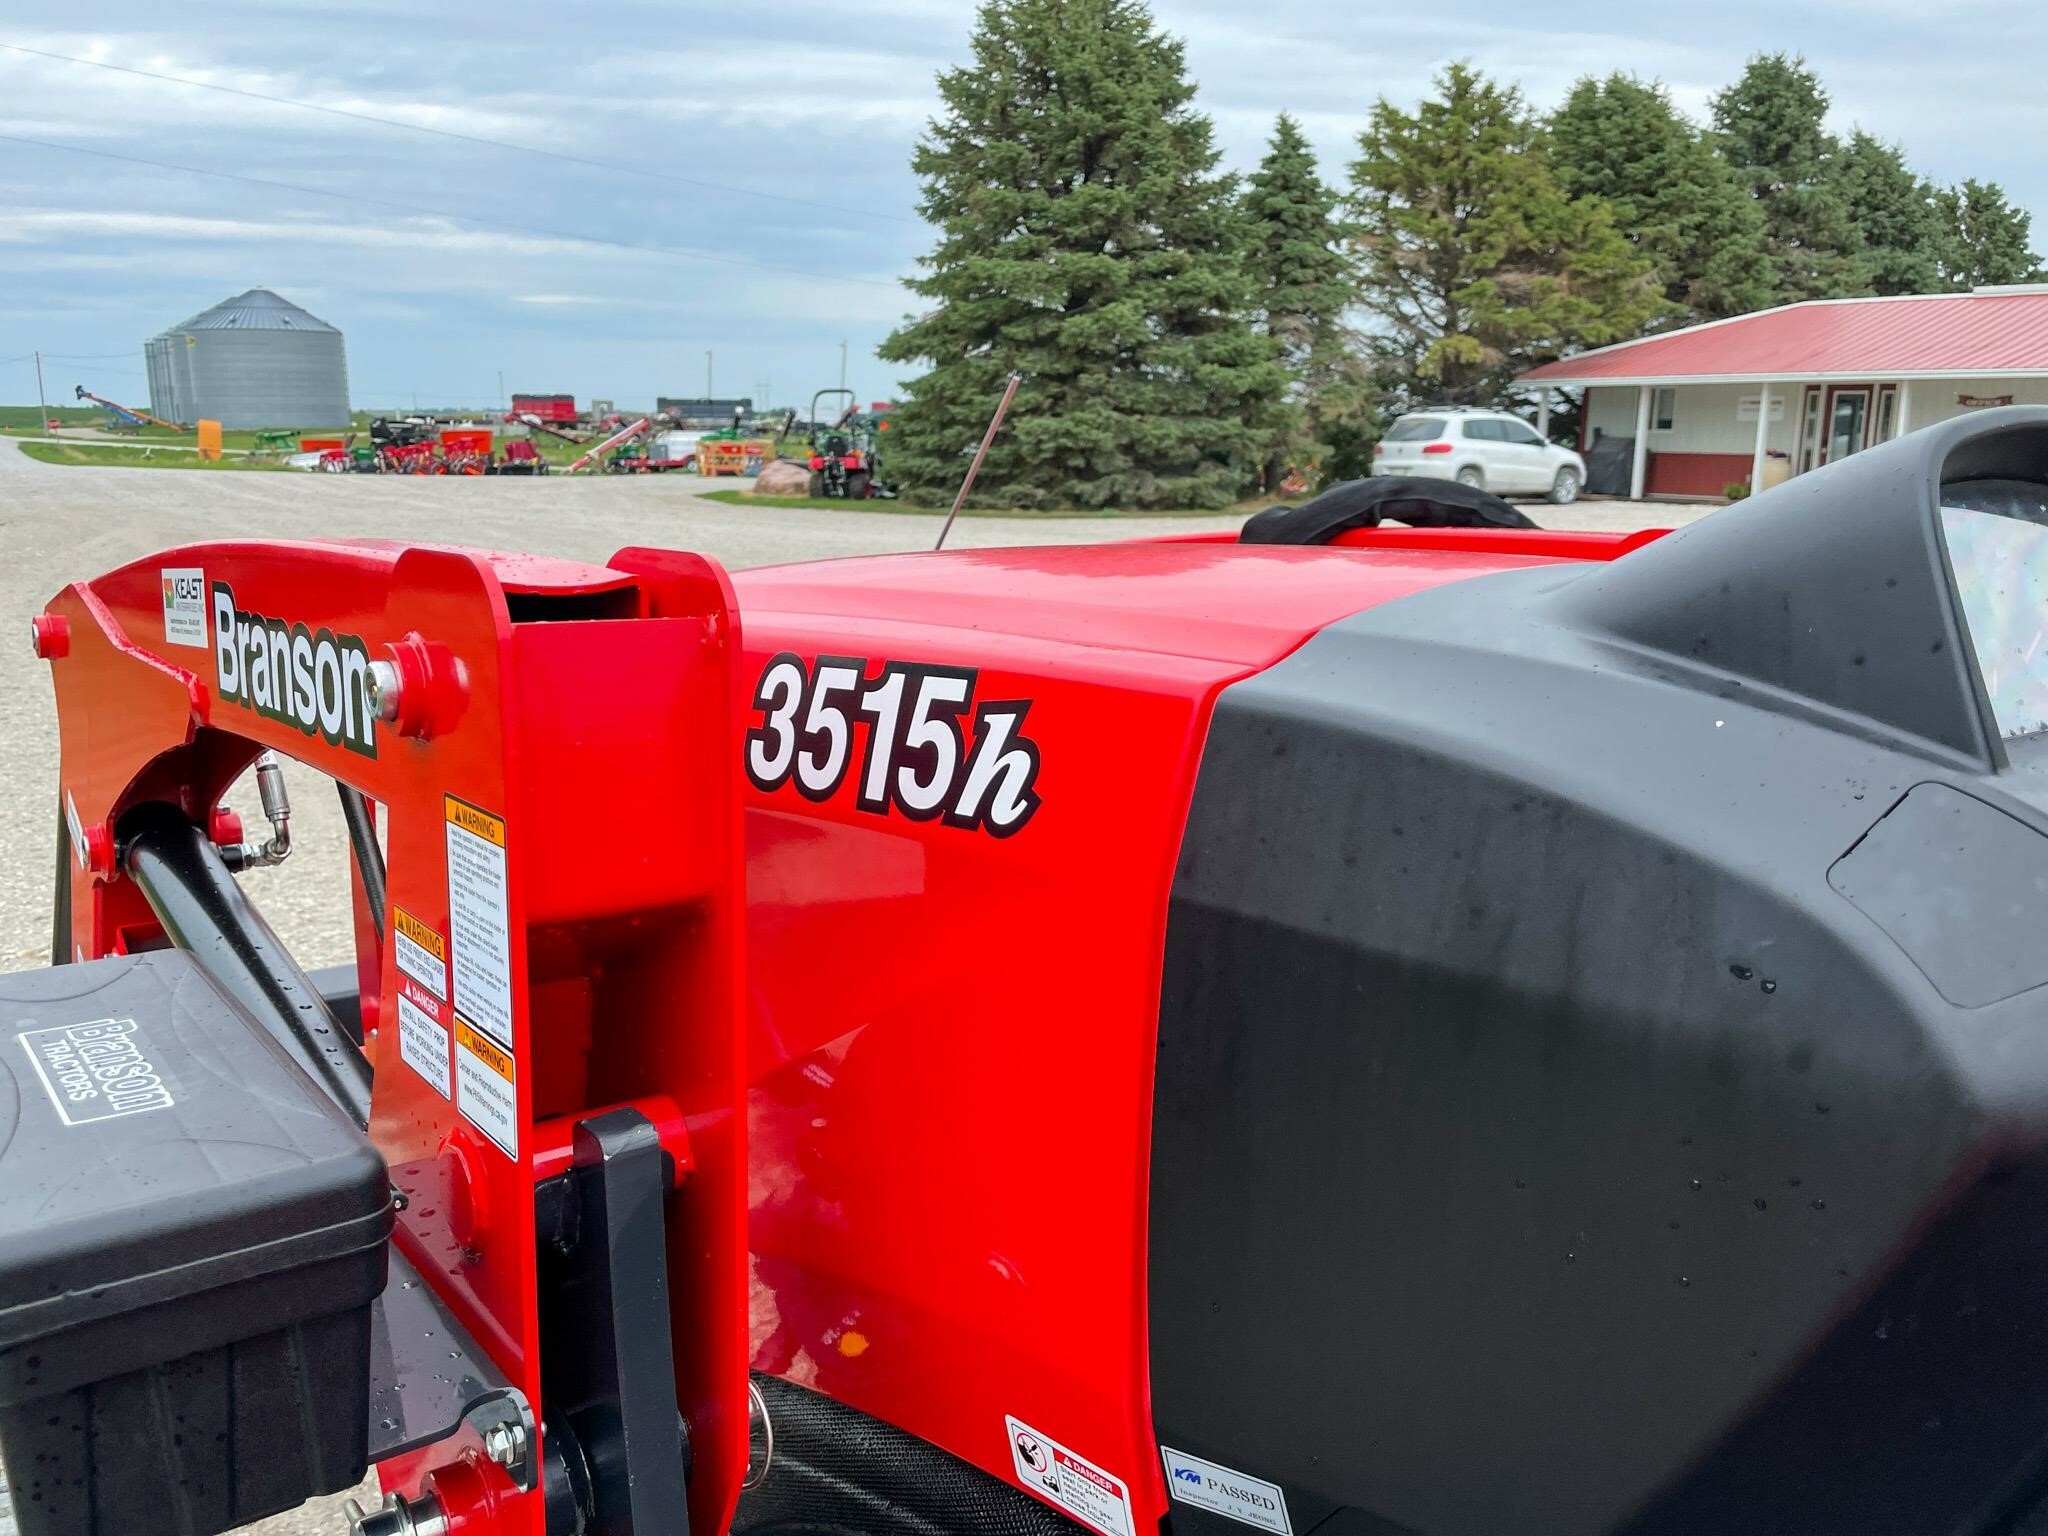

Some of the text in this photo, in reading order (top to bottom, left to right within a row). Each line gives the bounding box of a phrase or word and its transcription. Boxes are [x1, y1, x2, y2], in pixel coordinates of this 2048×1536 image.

[175, 578, 203, 600] KEAST
[213, 588, 376, 749] Branson
[747, 659, 1032, 829] 3515h
[462, 809, 496, 838] WARNING
[405, 917, 441, 956] WARNING
[412, 985, 439, 1018] DANGER
[418, 1016, 433, 1037] SAFETY
[400, 1019, 448, 1068] BEFORE WORKING UNDER
[472, 1038, 505, 1073] WARNING
[41, 1038, 99, 1101] TRACTORS
[65, 1018, 175, 1111] Branson
[458, 1057, 471, 1076] Cancer
[1060, 1465, 1109, 1498] Start only from
[1061, 1473, 1108, 1505] seat in park or
[1073, 1461, 1113, 1492] DANGER
[1174, 1467, 1275, 1511] KM PASSED
[1066, 1496, 1086, 1512] cause
[1091, 1503, 1098, 1512] in
[1099, 1510, 1113, 1521] gear
